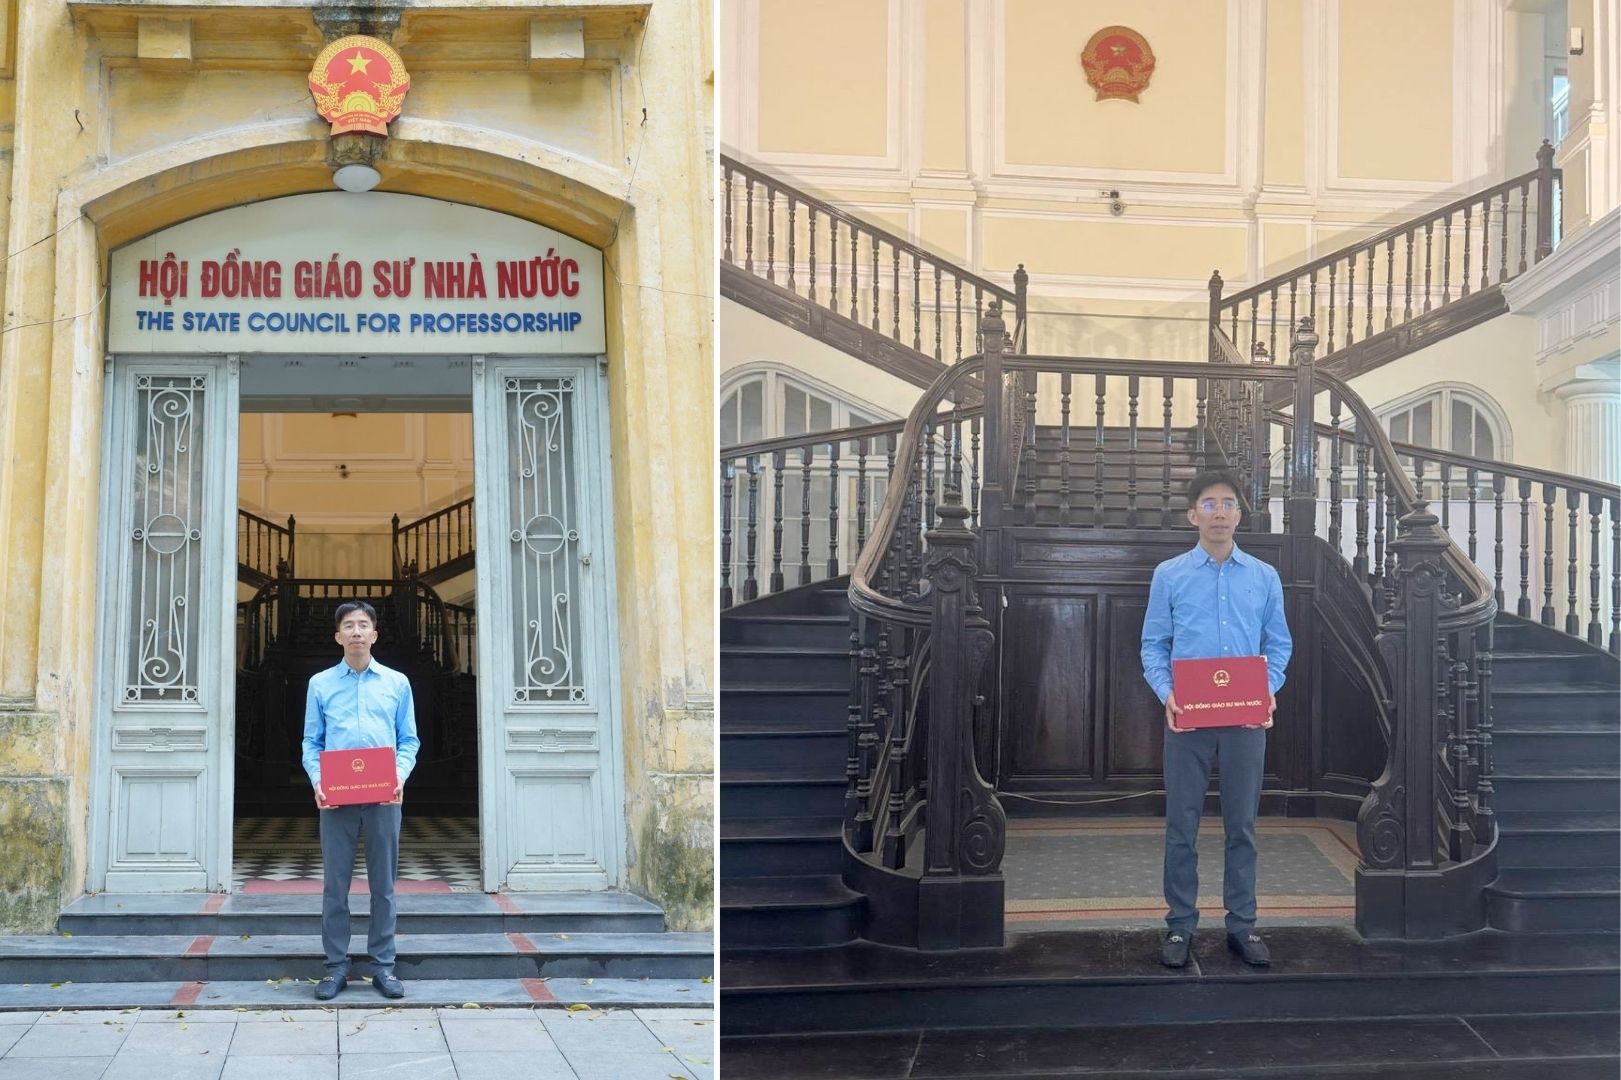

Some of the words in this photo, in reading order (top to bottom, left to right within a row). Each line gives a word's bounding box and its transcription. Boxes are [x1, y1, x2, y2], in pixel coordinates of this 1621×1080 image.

[138, 252, 188, 305] HỘI
[200, 248, 282, 298] ĐỒNG
[294, 253, 362, 298] GIÁO
[373, 257, 416, 298] SƯ
[424, 253, 487, 298] NHÀ
[497, 248, 580, 299] NƯỚC
[136, 310, 174, 331] THE
[182, 312, 240, 332] STATE
[248, 312, 350, 332] COUNCIL
[357, 312, 401, 333] FOR
[410, 312, 582, 333] PROFESSORSHIP
